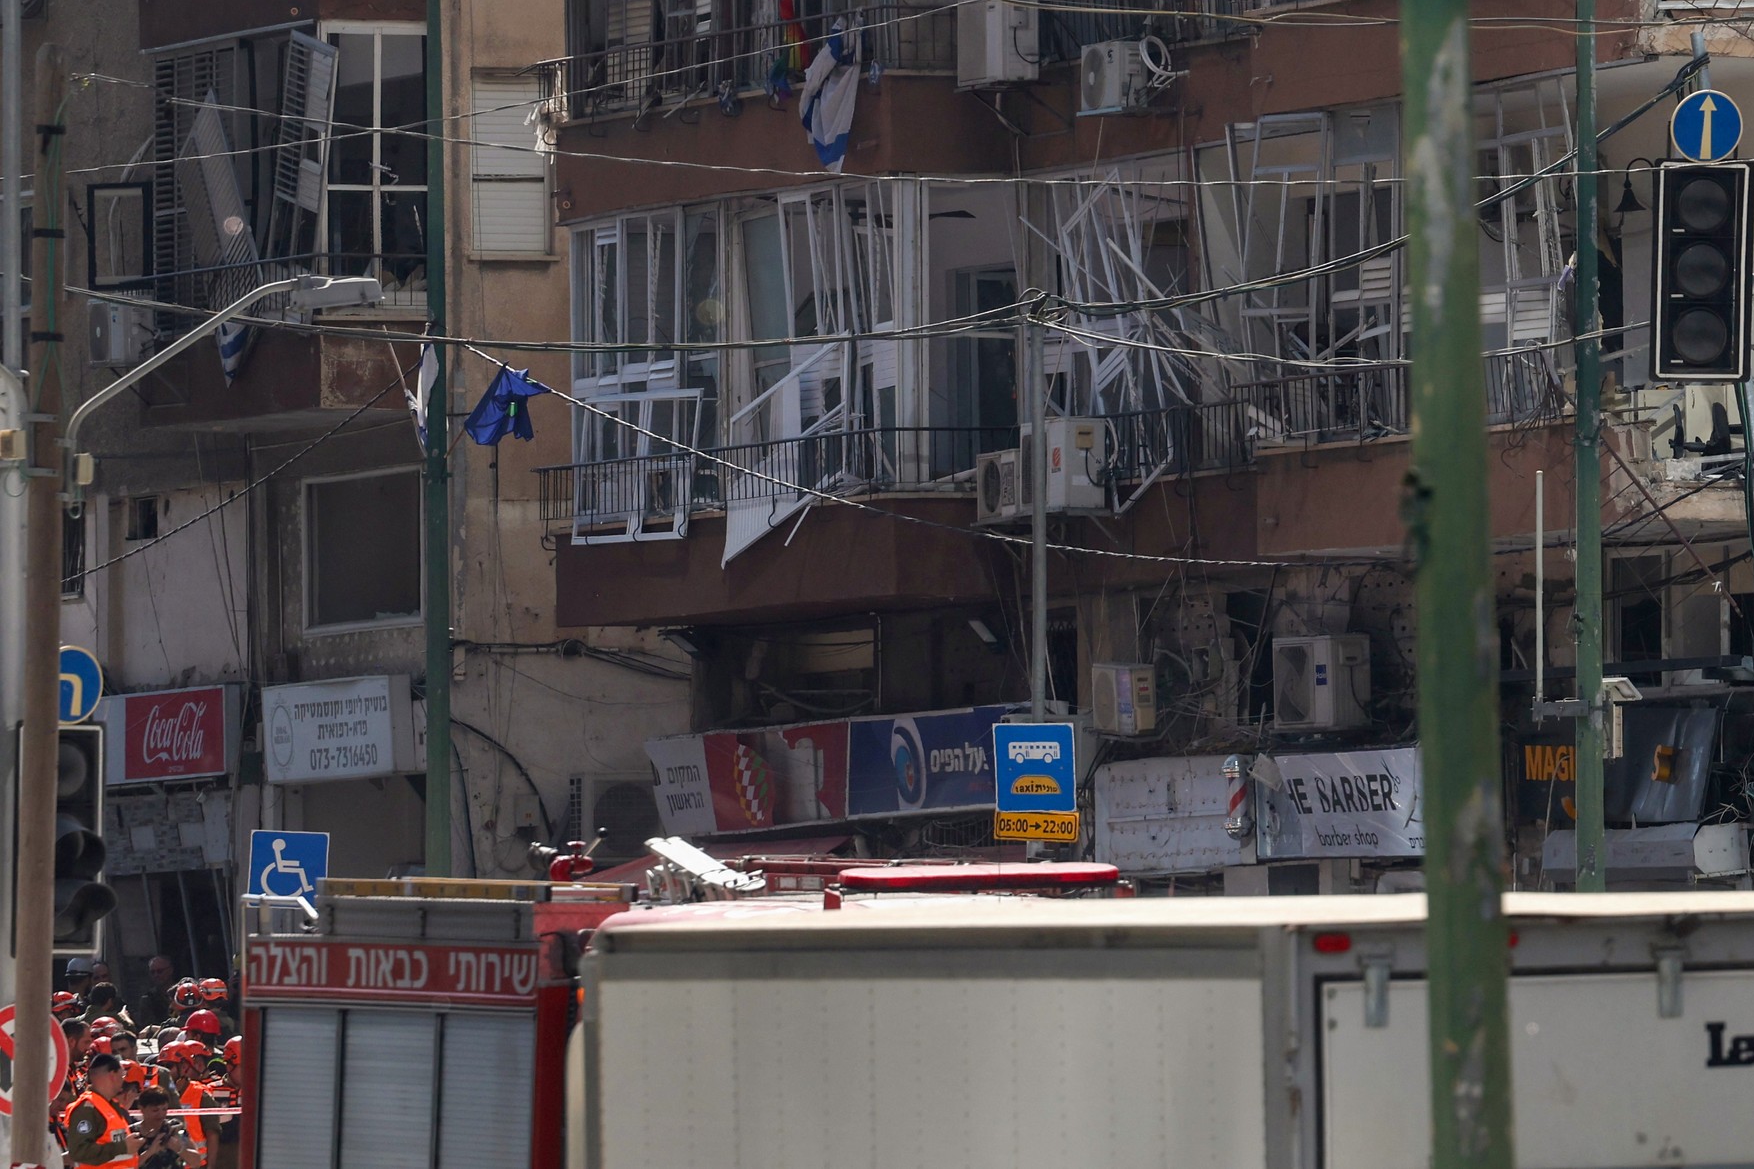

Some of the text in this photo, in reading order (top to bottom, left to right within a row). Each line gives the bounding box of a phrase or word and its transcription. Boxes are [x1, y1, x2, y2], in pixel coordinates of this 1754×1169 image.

[294, 699, 343, 723] וקוסמטיקה
[364, 695, 388, 716] בוטיק
[309, 743, 378, 771] 073-7316450
[930, 748, 964, 773] הפיס
[1525, 745, 1576, 781] MAGI
[666, 764, 701, 788] המקום
[1015, 780, 1034, 793] taxi
[666, 791, 705, 817] הראשון
[1287, 778, 1313, 815] HE
[1000, 818, 1073, 835] 05:00 22:00
[1315, 824, 1379, 849] barber shop
[251, 942, 536, 995] שירותי כבאות והצלה
